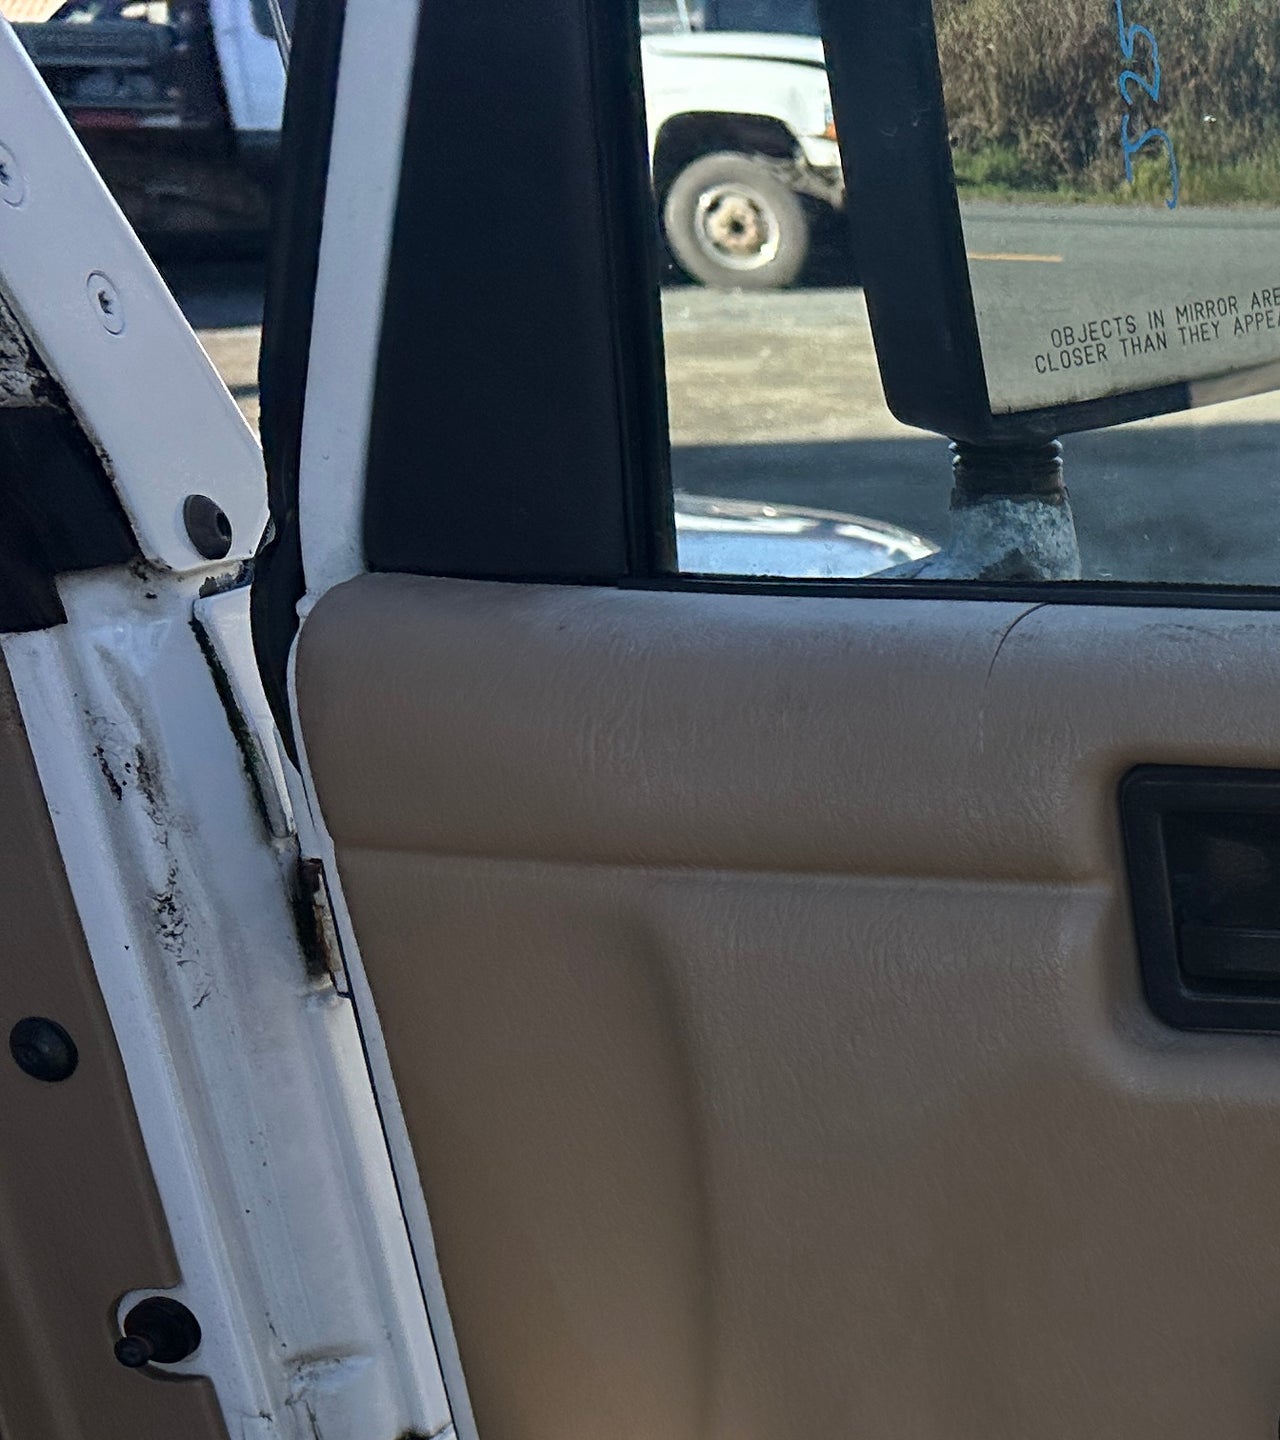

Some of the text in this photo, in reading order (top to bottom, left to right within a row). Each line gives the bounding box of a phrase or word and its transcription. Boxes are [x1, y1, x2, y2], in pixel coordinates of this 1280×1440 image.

[1035, 343, 1108, 374] CLOSER
[1119, 332, 1168, 357] THAN
[1178, 320, 1220, 346] THEY
[1051, 315, 1137, 348] OBJECTS
[1148, 309, 1165, 330] IN
[1176, 295, 1239, 325] MIRROR
